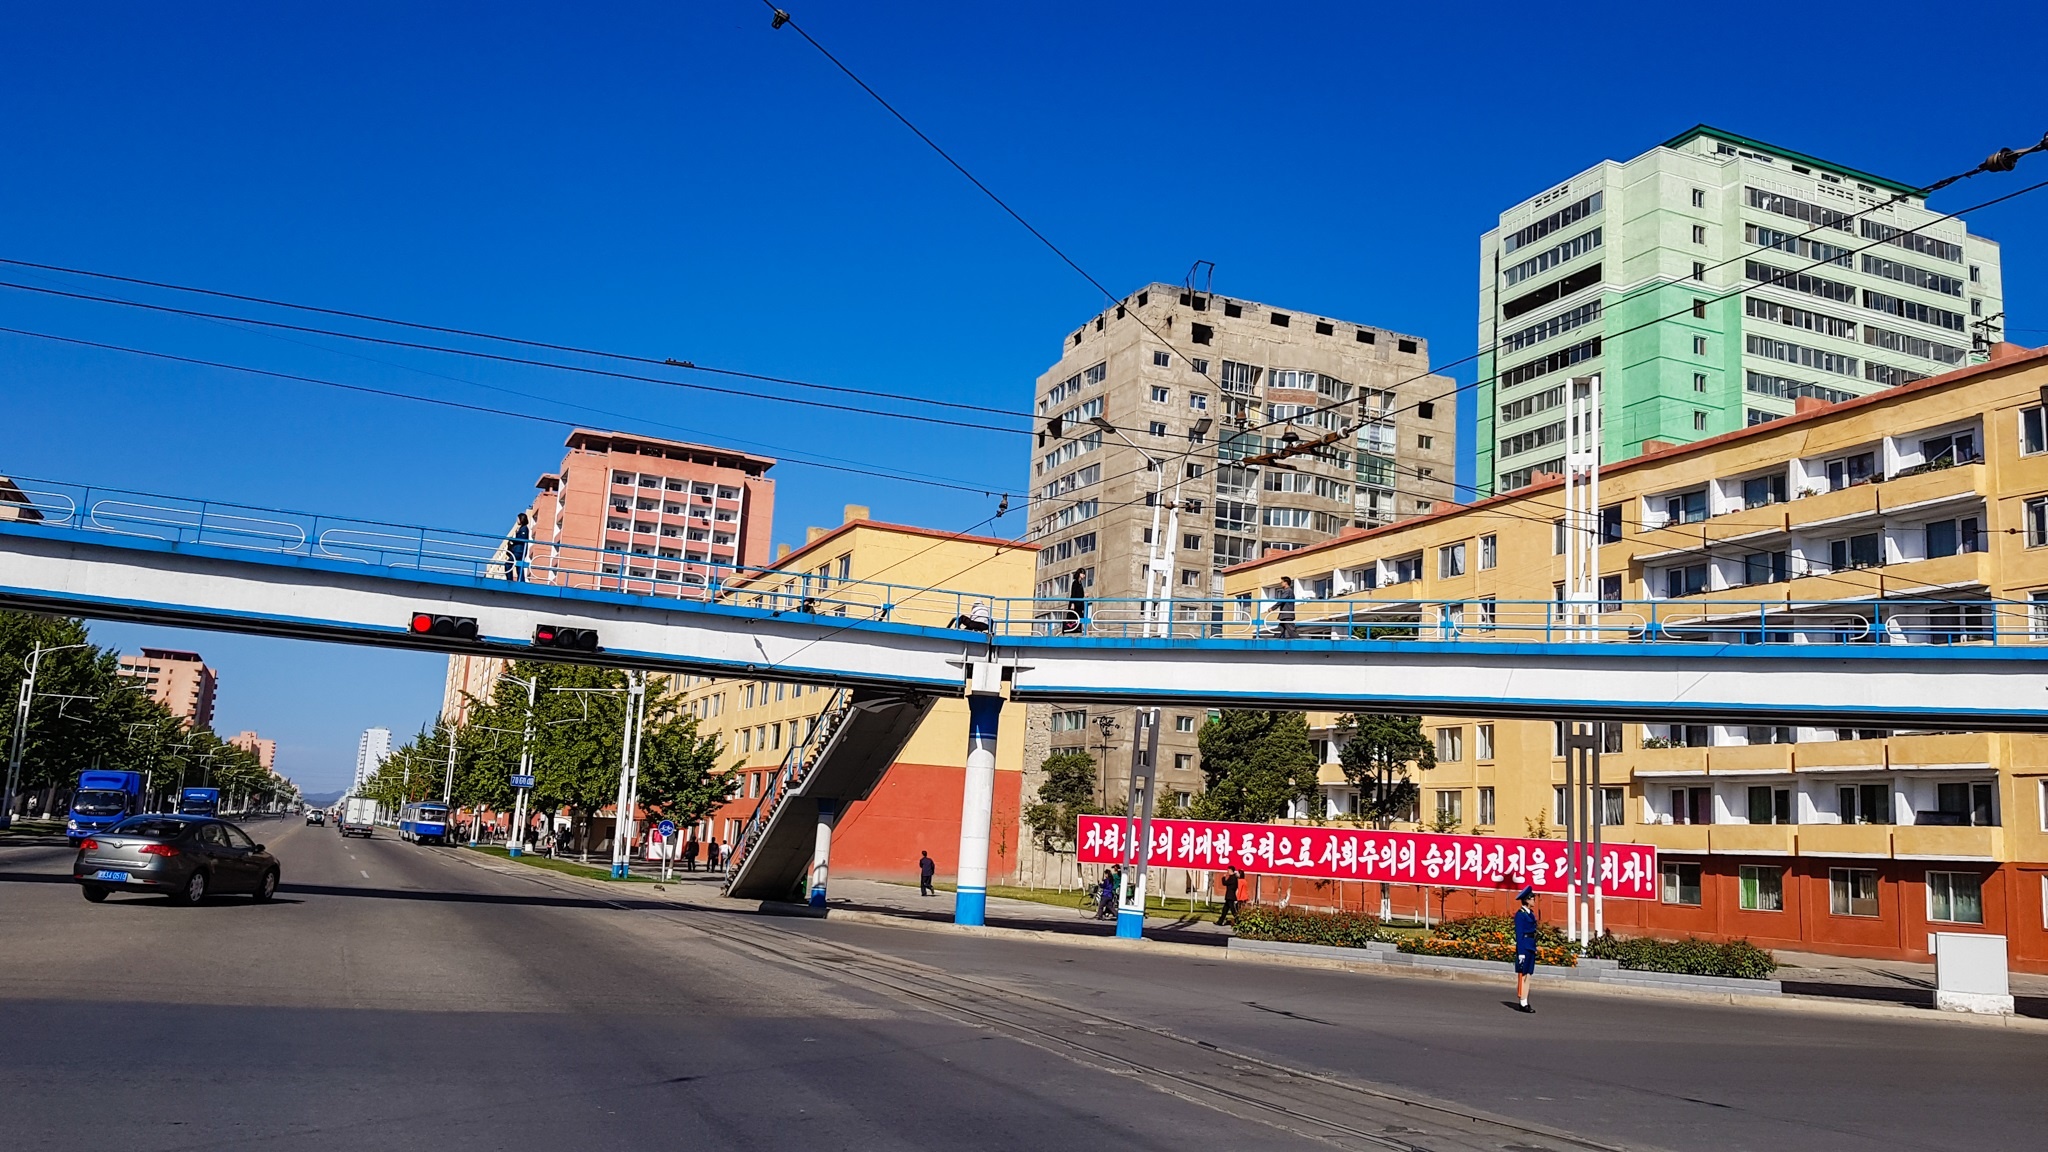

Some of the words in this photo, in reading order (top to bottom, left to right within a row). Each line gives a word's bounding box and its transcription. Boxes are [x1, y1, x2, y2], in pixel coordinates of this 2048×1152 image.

[1177, 827, 1233, 864] 위대한
[1237, 832, 1314, 868] 동력으로
[1318, 835, 1415, 877] 사회주의의
[1421, 842, 1549, 885] 승리적전진을
